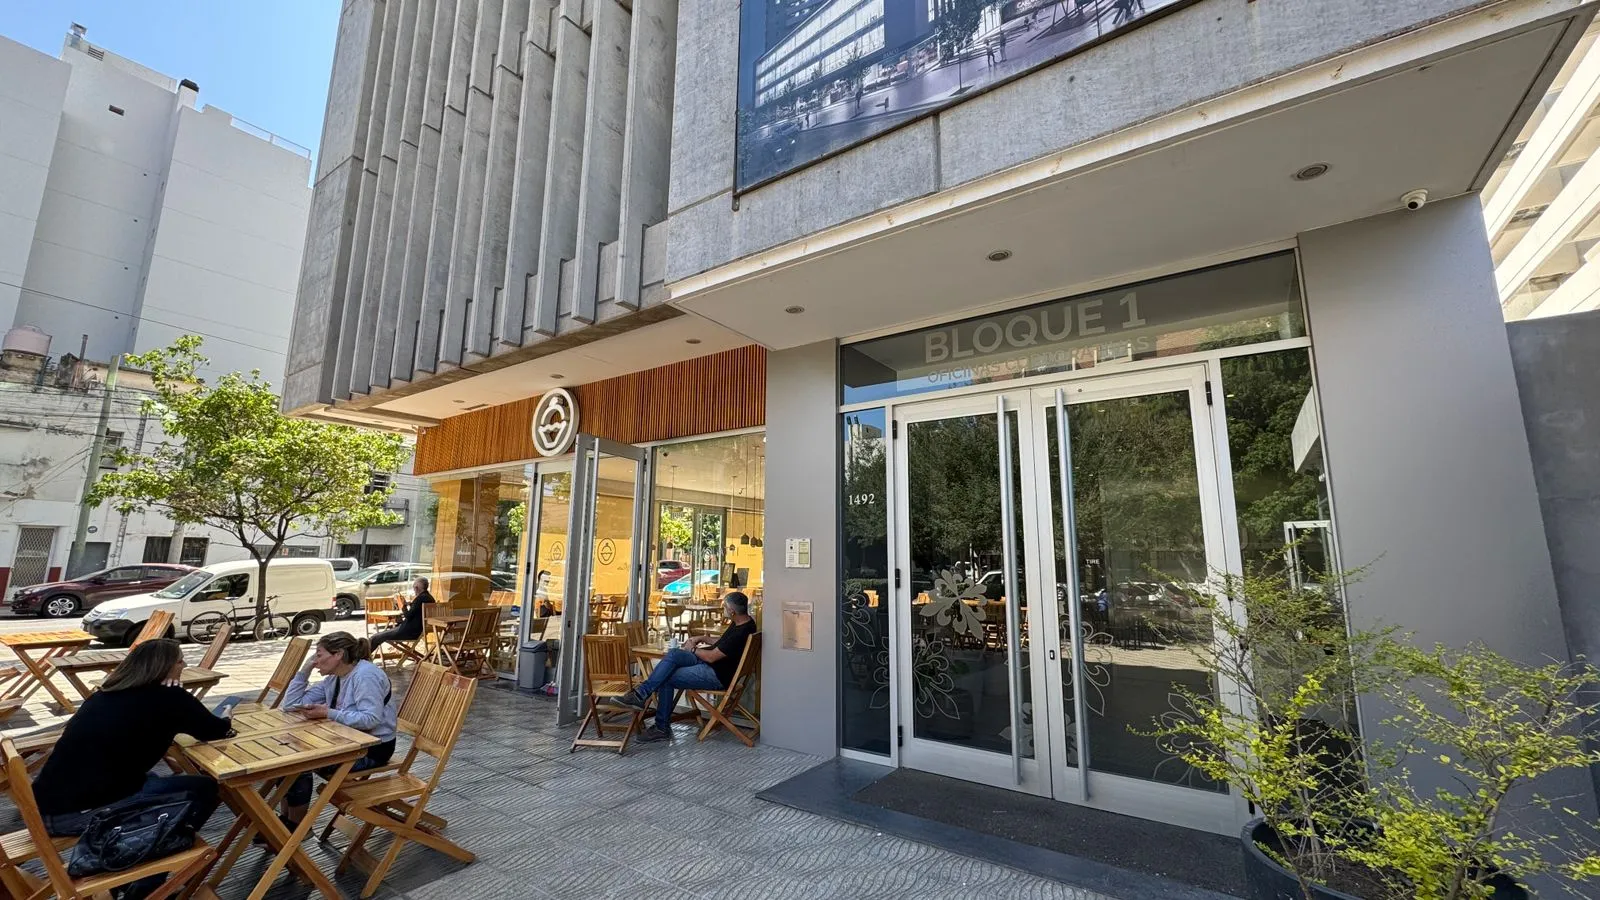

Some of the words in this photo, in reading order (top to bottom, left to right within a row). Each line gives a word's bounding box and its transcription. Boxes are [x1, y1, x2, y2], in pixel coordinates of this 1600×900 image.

[925, 300, 1106, 361] BLOQUE
[1119, 291, 1147, 329] 1
[928, 361, 1000, 383] OFICINAS
[848, 493, 875, 506] 1492
